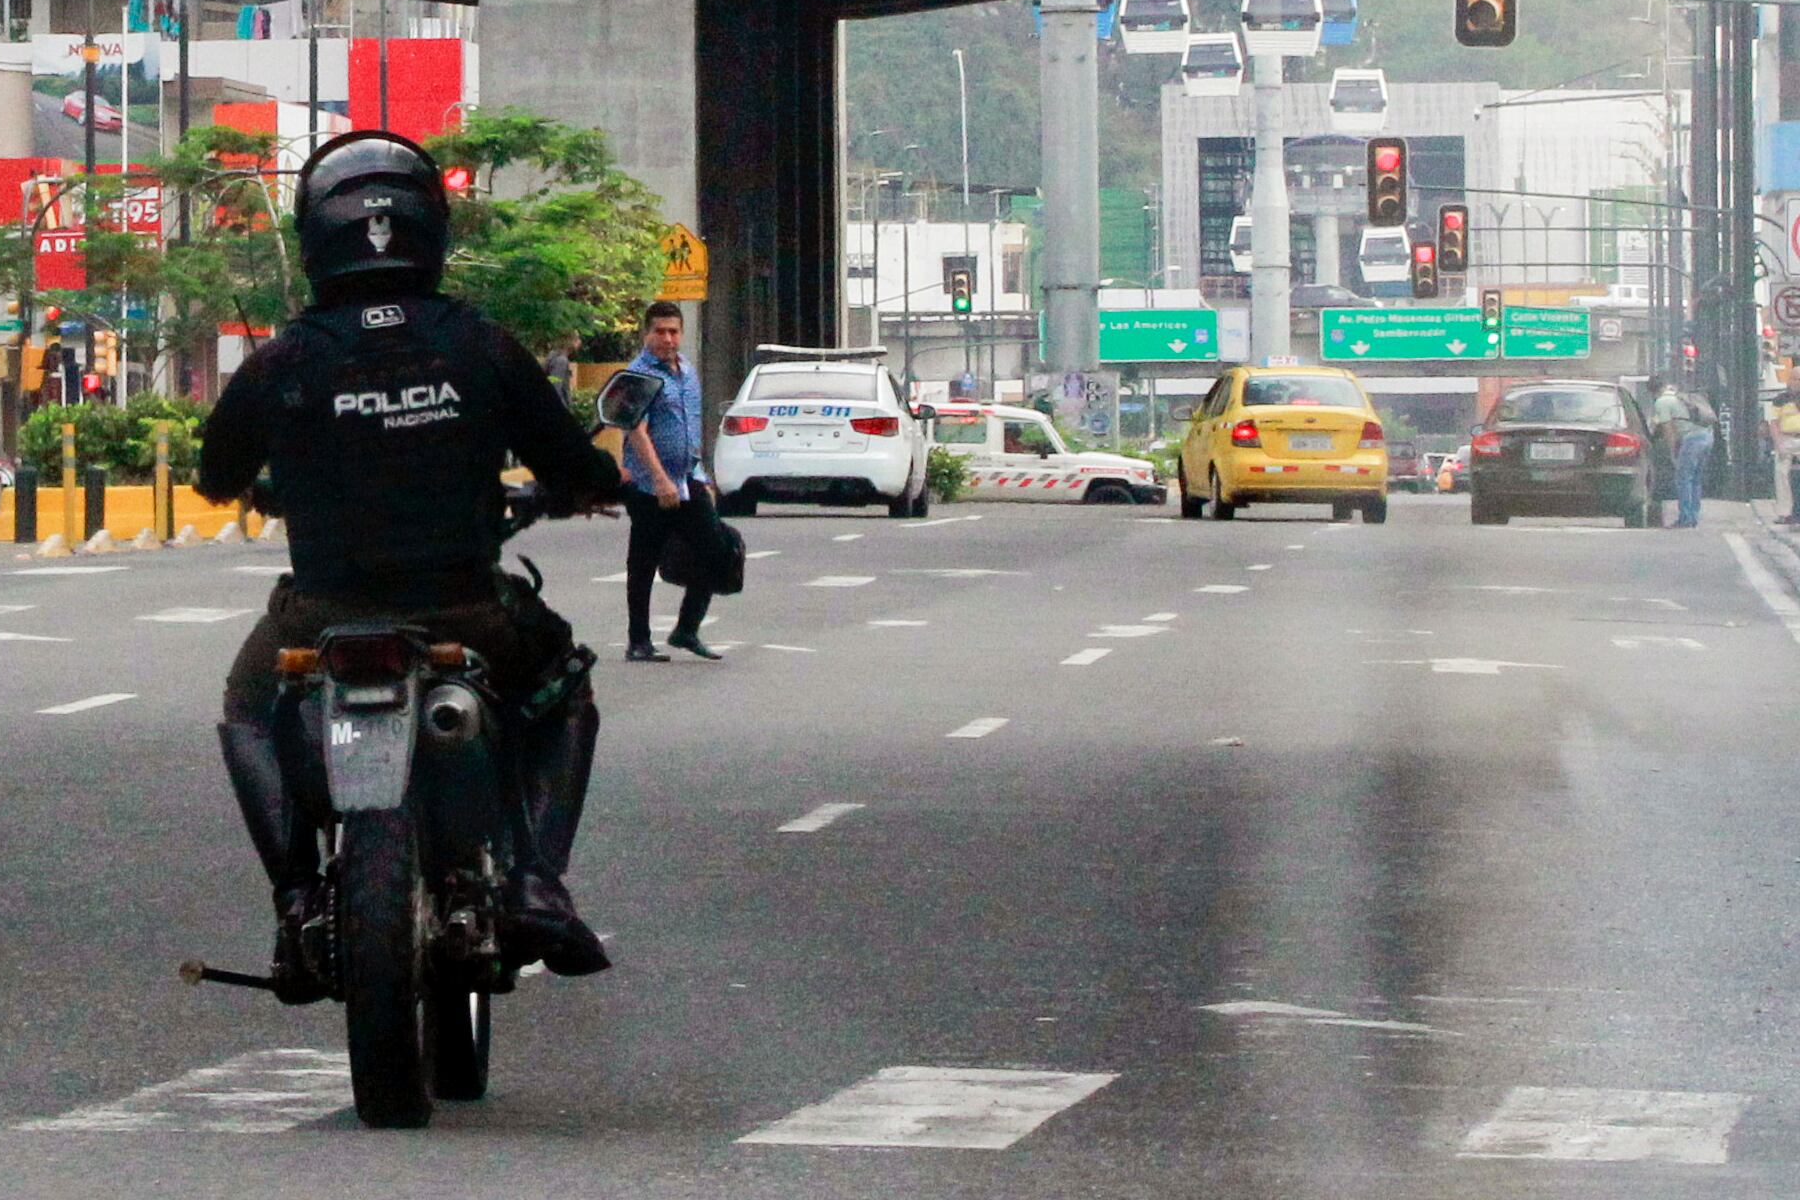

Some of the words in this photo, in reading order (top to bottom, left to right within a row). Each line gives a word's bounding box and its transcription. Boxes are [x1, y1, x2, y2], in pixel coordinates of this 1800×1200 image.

[334, 382, 460, 417] POLICIA
[768, 405, 800, 417] ECU
[821, 405, 853, 418] 911
